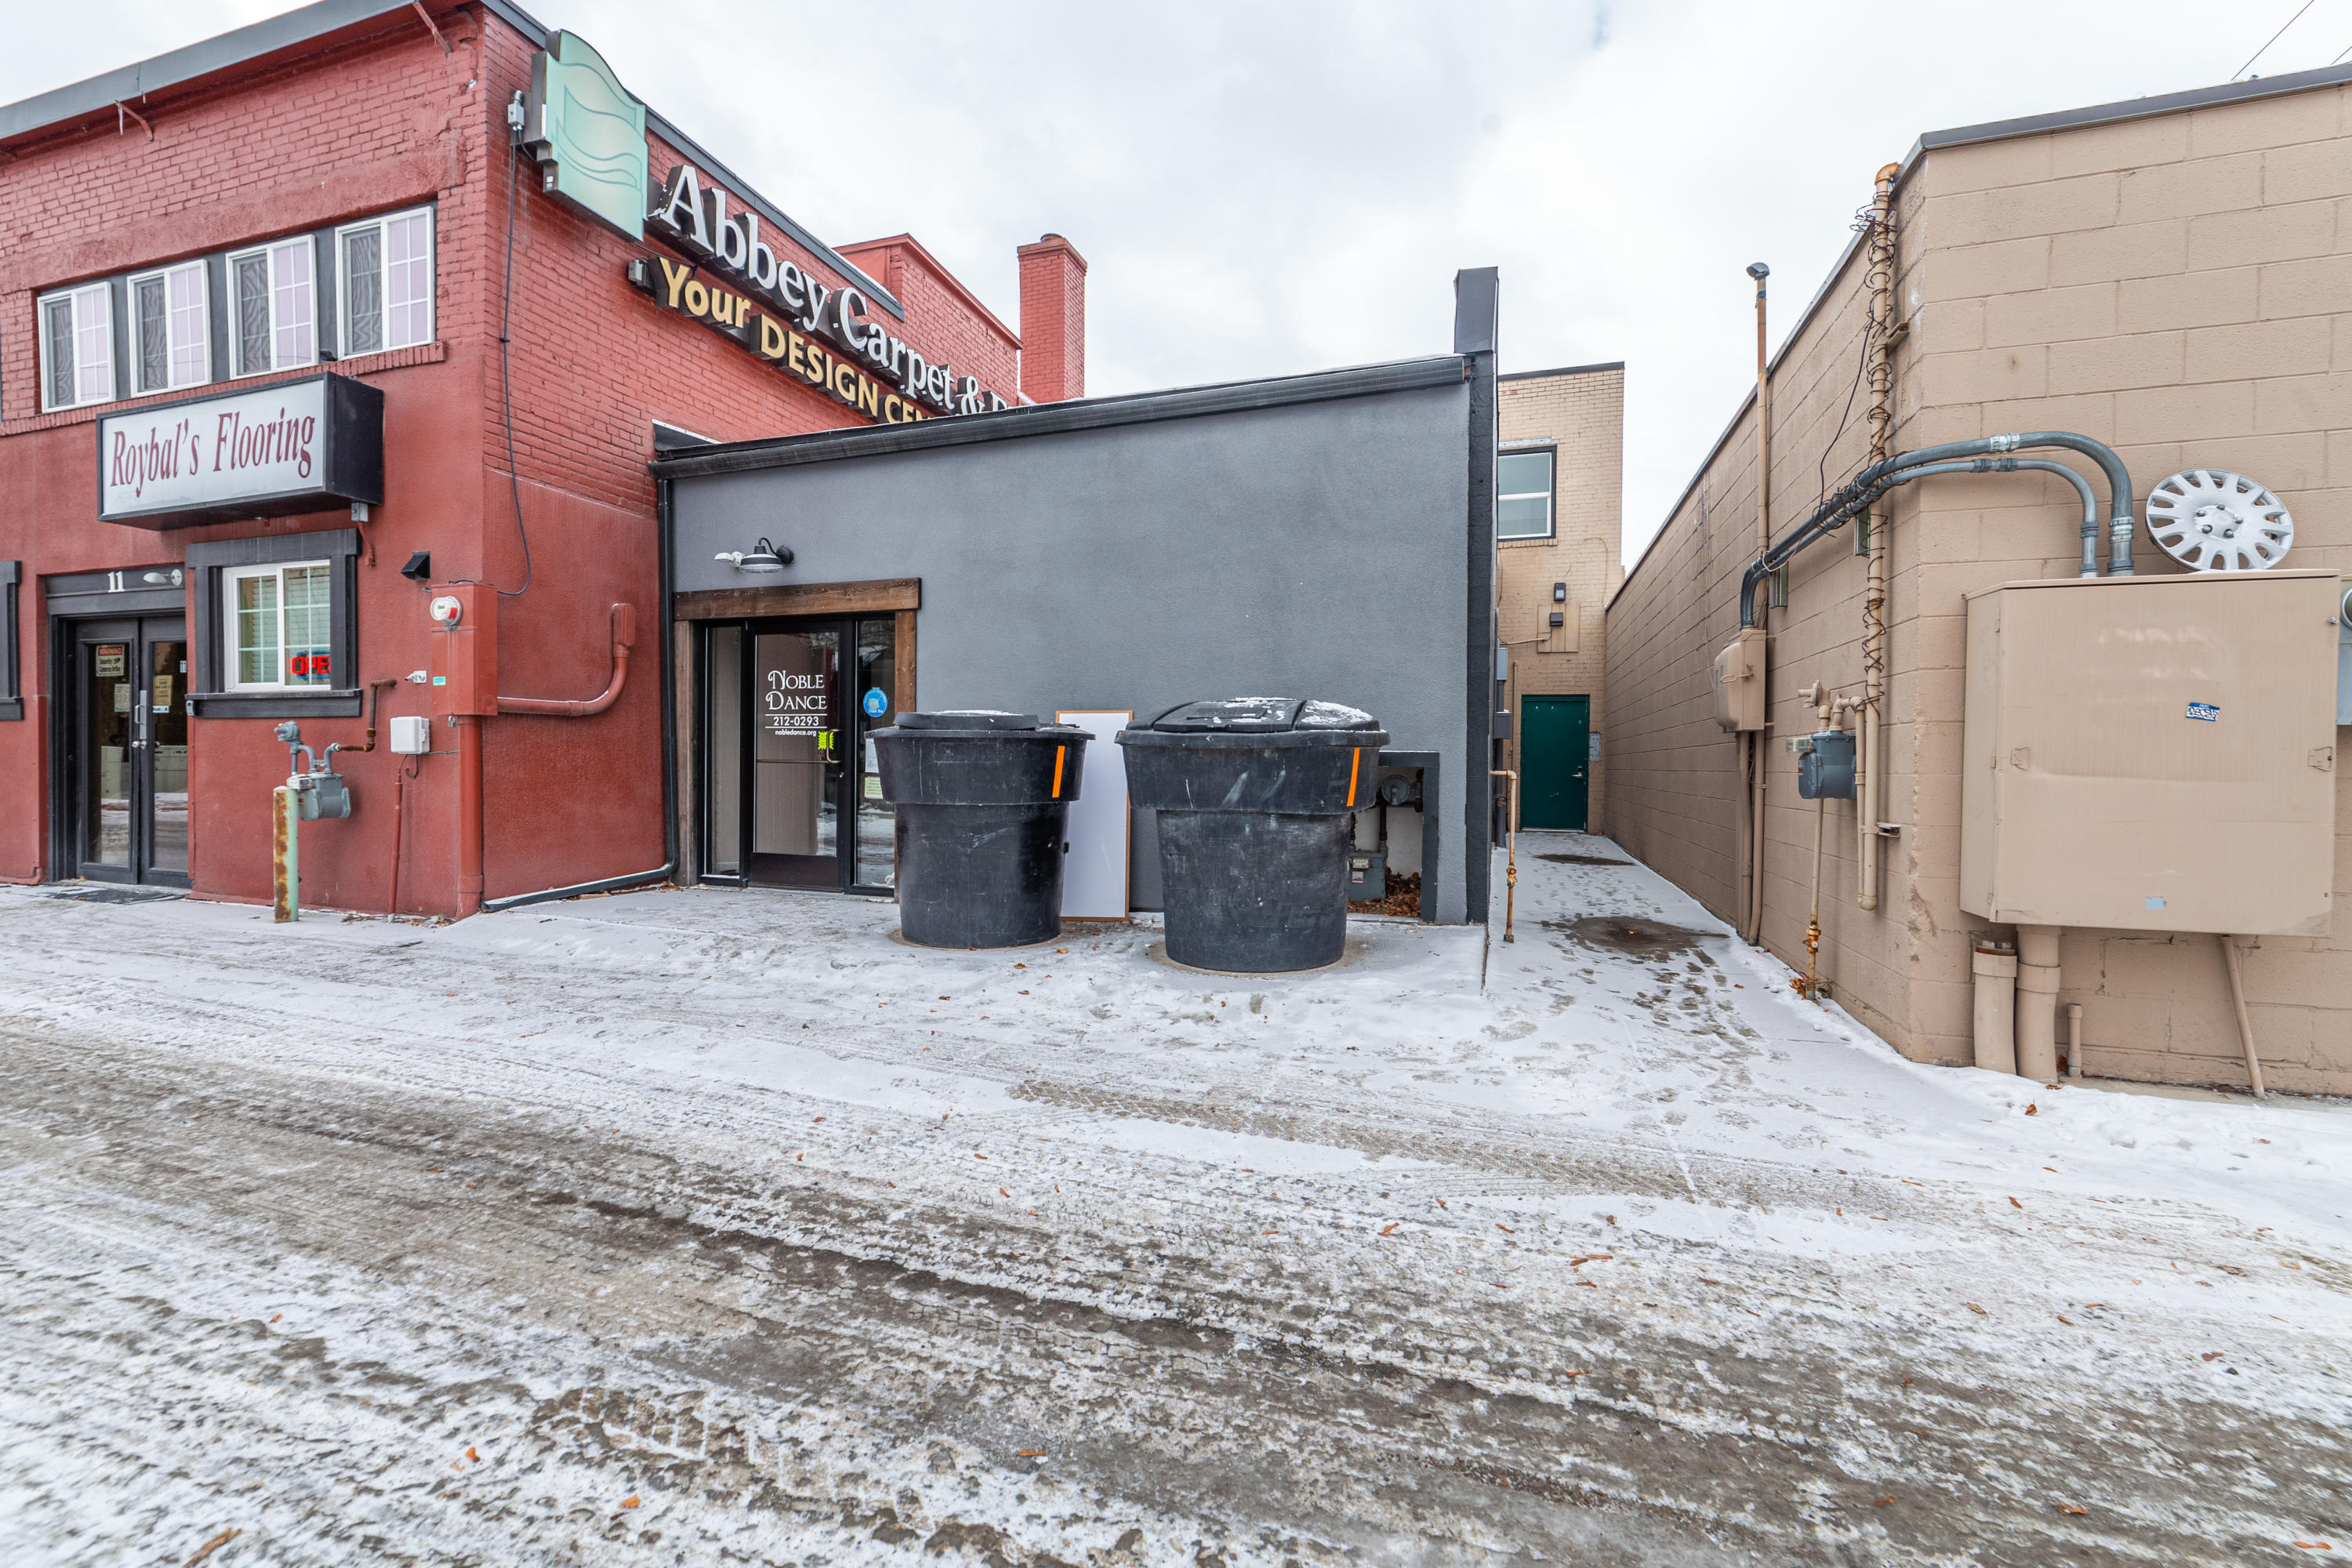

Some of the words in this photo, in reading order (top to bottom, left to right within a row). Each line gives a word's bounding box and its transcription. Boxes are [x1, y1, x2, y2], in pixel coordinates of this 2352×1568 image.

[659, 164, 829, 332] Abbey
[840, 286, 955, 410] Carpet
[955, 376, 985, 416] &
[659, 257, 751, 328] Your
[760, 314, 878, 417] DESIGN
[111, 417, 200, 498] Roybal's
[212, 407, 315, 478] Flooring
[107, 571, 125, 593] 11
[291, 655, 331, 674] OPE
[773, 716, 819, 727] 212-0293
